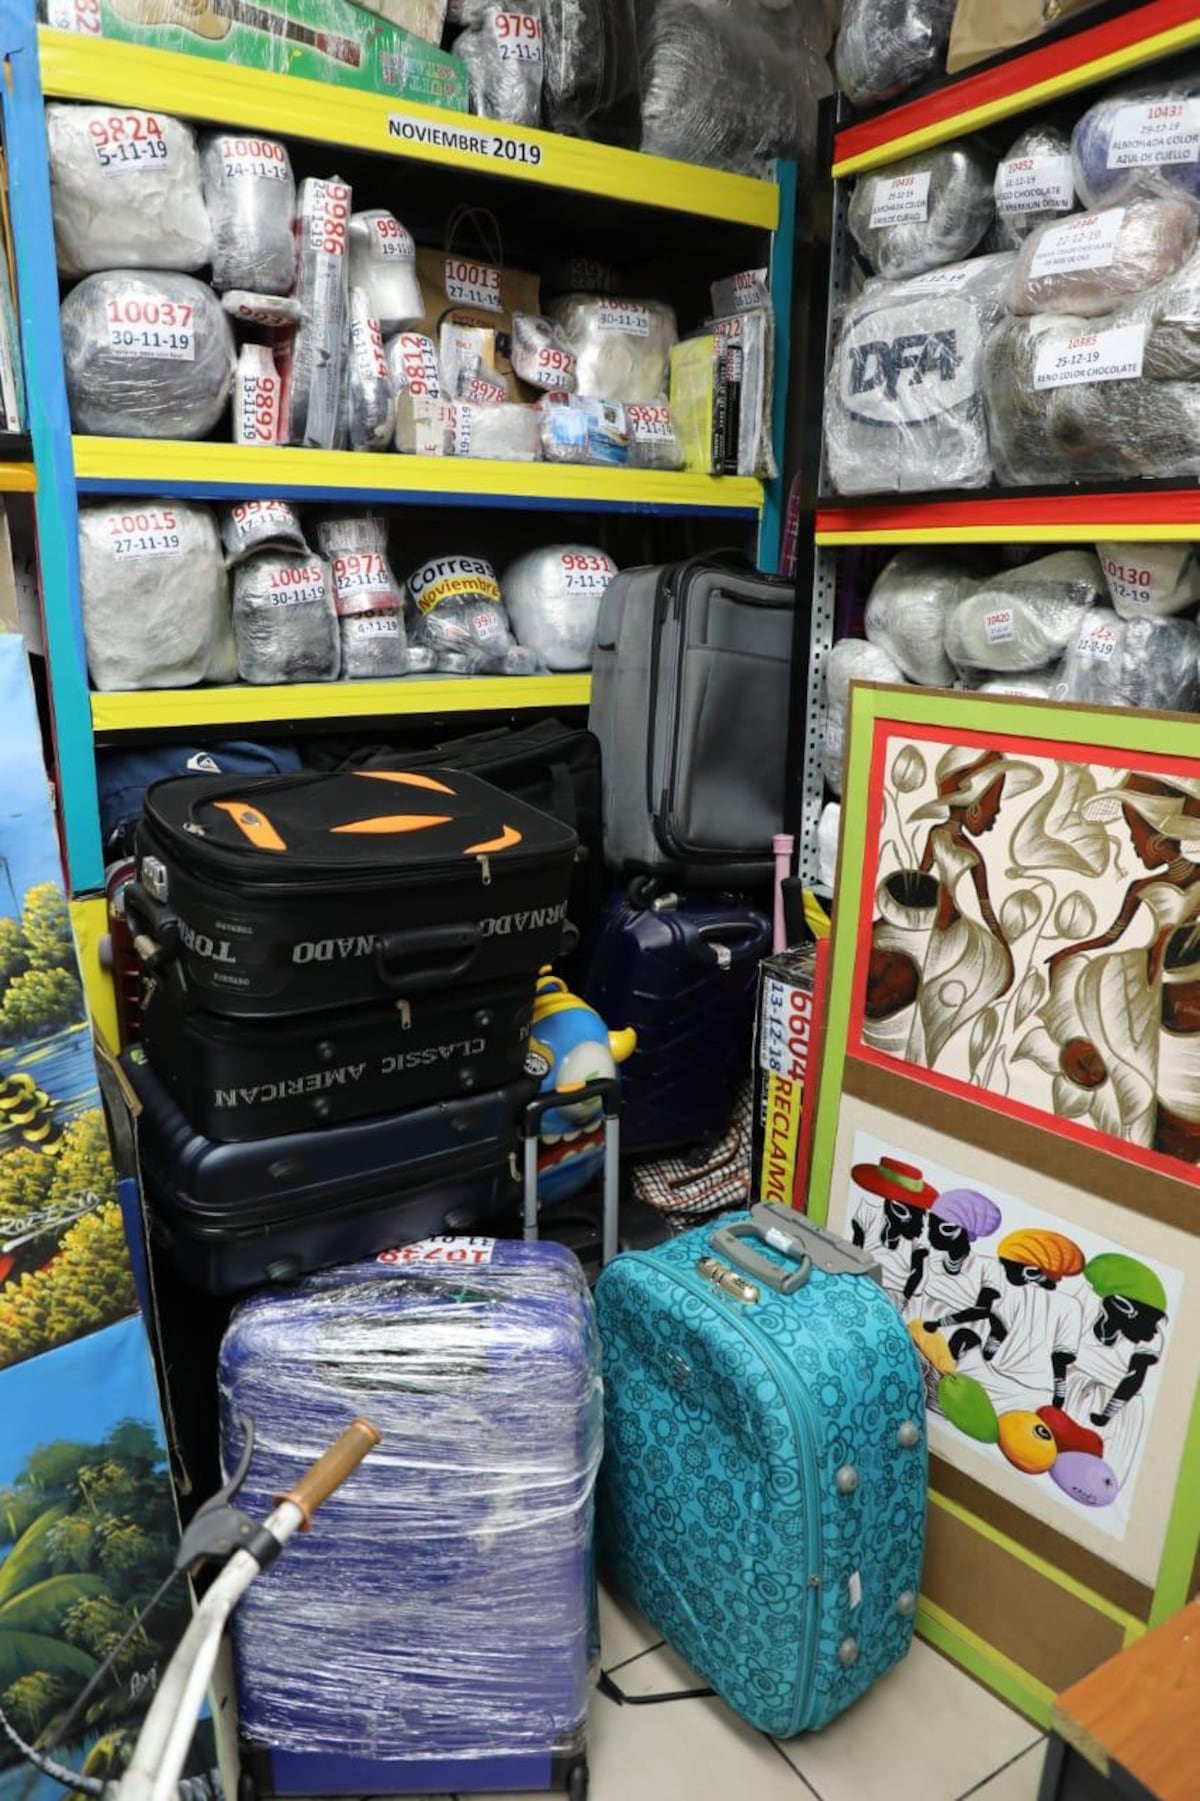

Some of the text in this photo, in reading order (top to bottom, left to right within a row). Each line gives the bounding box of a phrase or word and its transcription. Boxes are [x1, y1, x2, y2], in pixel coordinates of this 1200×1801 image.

[88, 115, 164, 147] 9824
[388, 118, 542, 165] NOVIEMBRE 2019
[1111, 134, 1199, 150] ALMOHADA COLOR
[98, 139, 169, 167] 5-11-19
[222, 139, 286, 163] 10000
[1115, 152, 1139, 163] AZUL
[1154, 149, 1191, 162] CUELLO
[311, 180, 327, 248] 24-11-19
[322, 185, 349, 255] 9986
[446, 261, 501, 289] 10013
[106, 300, 194, 328] 10037
[111, 329, 190, 350] 30-11-19
[400, 335, 427, 397] 9812
[1086, 363, 1138, 378] CHOCOLATE
[243, 375, 257, 441] 13-11-19
[255, 377, 276, 442] 9892
[627, 405, 671, 424] 9829
[458, 405, 473, 455] 19-11-19
[110, 511, 177, 535] 10015
[114, 534, 180, 554] 27-11-19
[270, 565, 322, 588] 10045
[333, 554, 385, 578] 9971
[410, 558, 498, 595] Correas
[561, 553, 611, 573] 9831
[271, 586, 326, 606] 30-11-19
[418, 577, 500, 611] Noviembre
[769, 981, 785, 1072] 13-12-18
[787, 989, 813, 1082] 6604
[214, 1037, 487, 1108] CLASSIC AMERICAN
